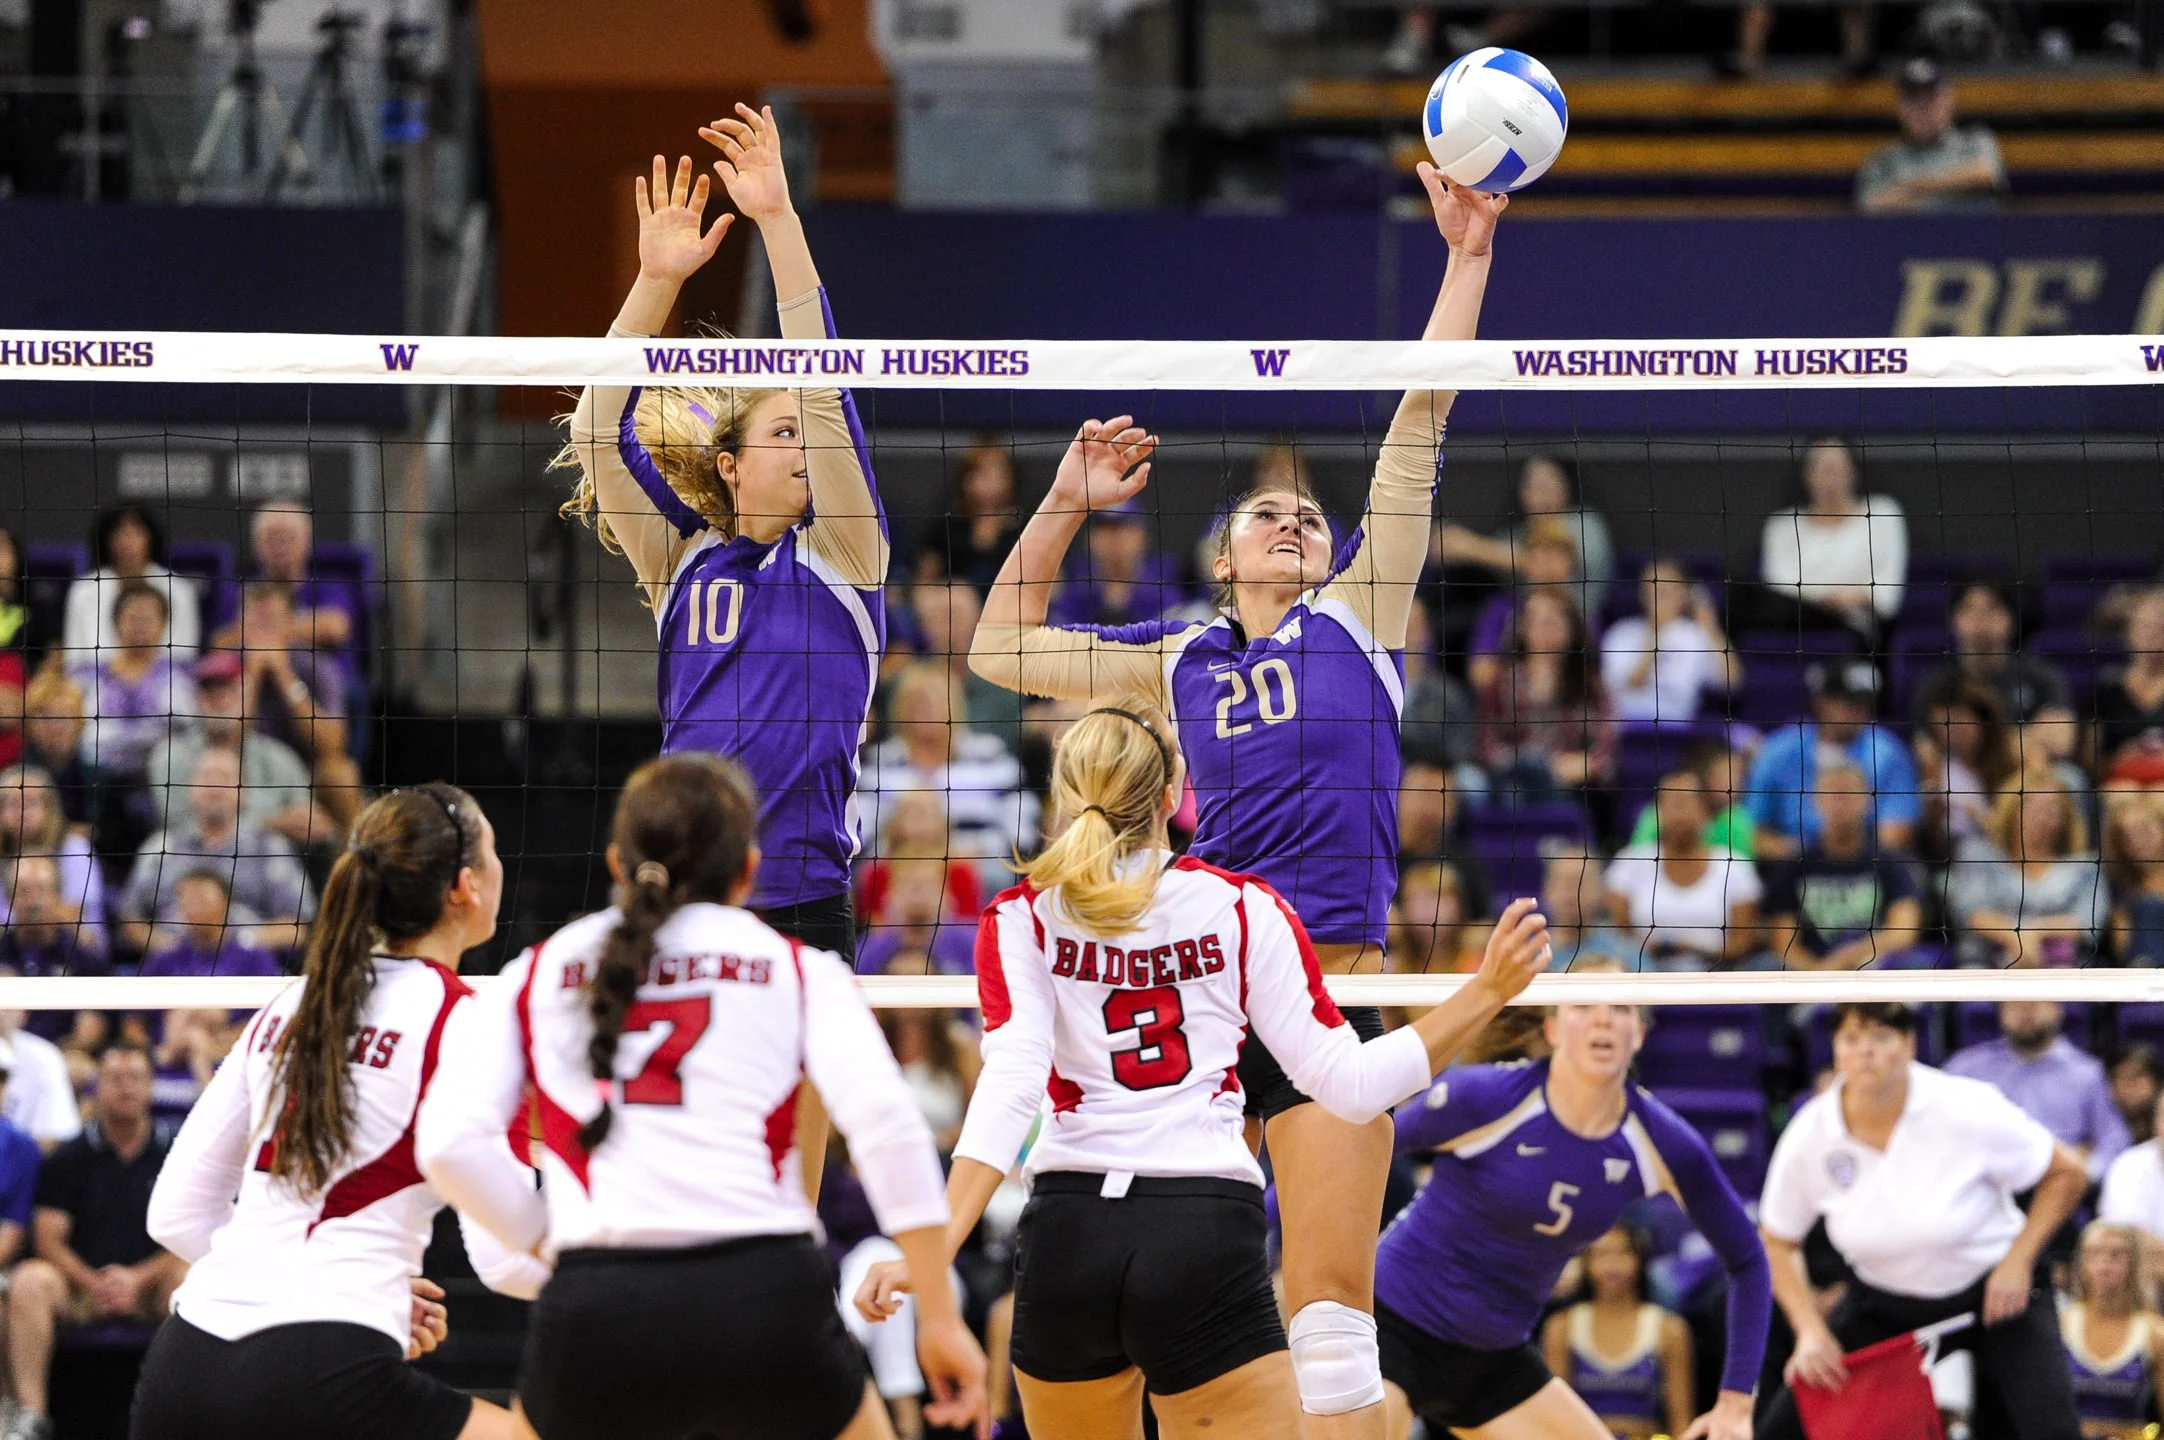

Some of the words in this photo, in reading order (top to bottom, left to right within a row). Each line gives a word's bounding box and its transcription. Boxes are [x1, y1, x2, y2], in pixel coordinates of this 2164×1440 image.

[0, 340, 154, 368] HUSKIES
[379, 343, 420, 373] W
[643, 347, 865, 376] WASHINGTON
[880, 349, 1030, 377] HUSKIES
[1250, 349, 1291, 377] W
[1512, 350, 1739, 377] WASHINGTON
[1754, 348, 1909, 377] HUSKIES
[687, 578, 744, 646] 10
[1271, 615, 1302, 646] W
[1214, 658, 1297, 739] 20
[562, 954, 771, 988] BGERS
[1052, 933, 1226, 987] BADGERS
[618, 994, 713, 1106] 7
[1101, 985, 1193, 1092] 3
[1533, 1180, 1581, 1236] 5
